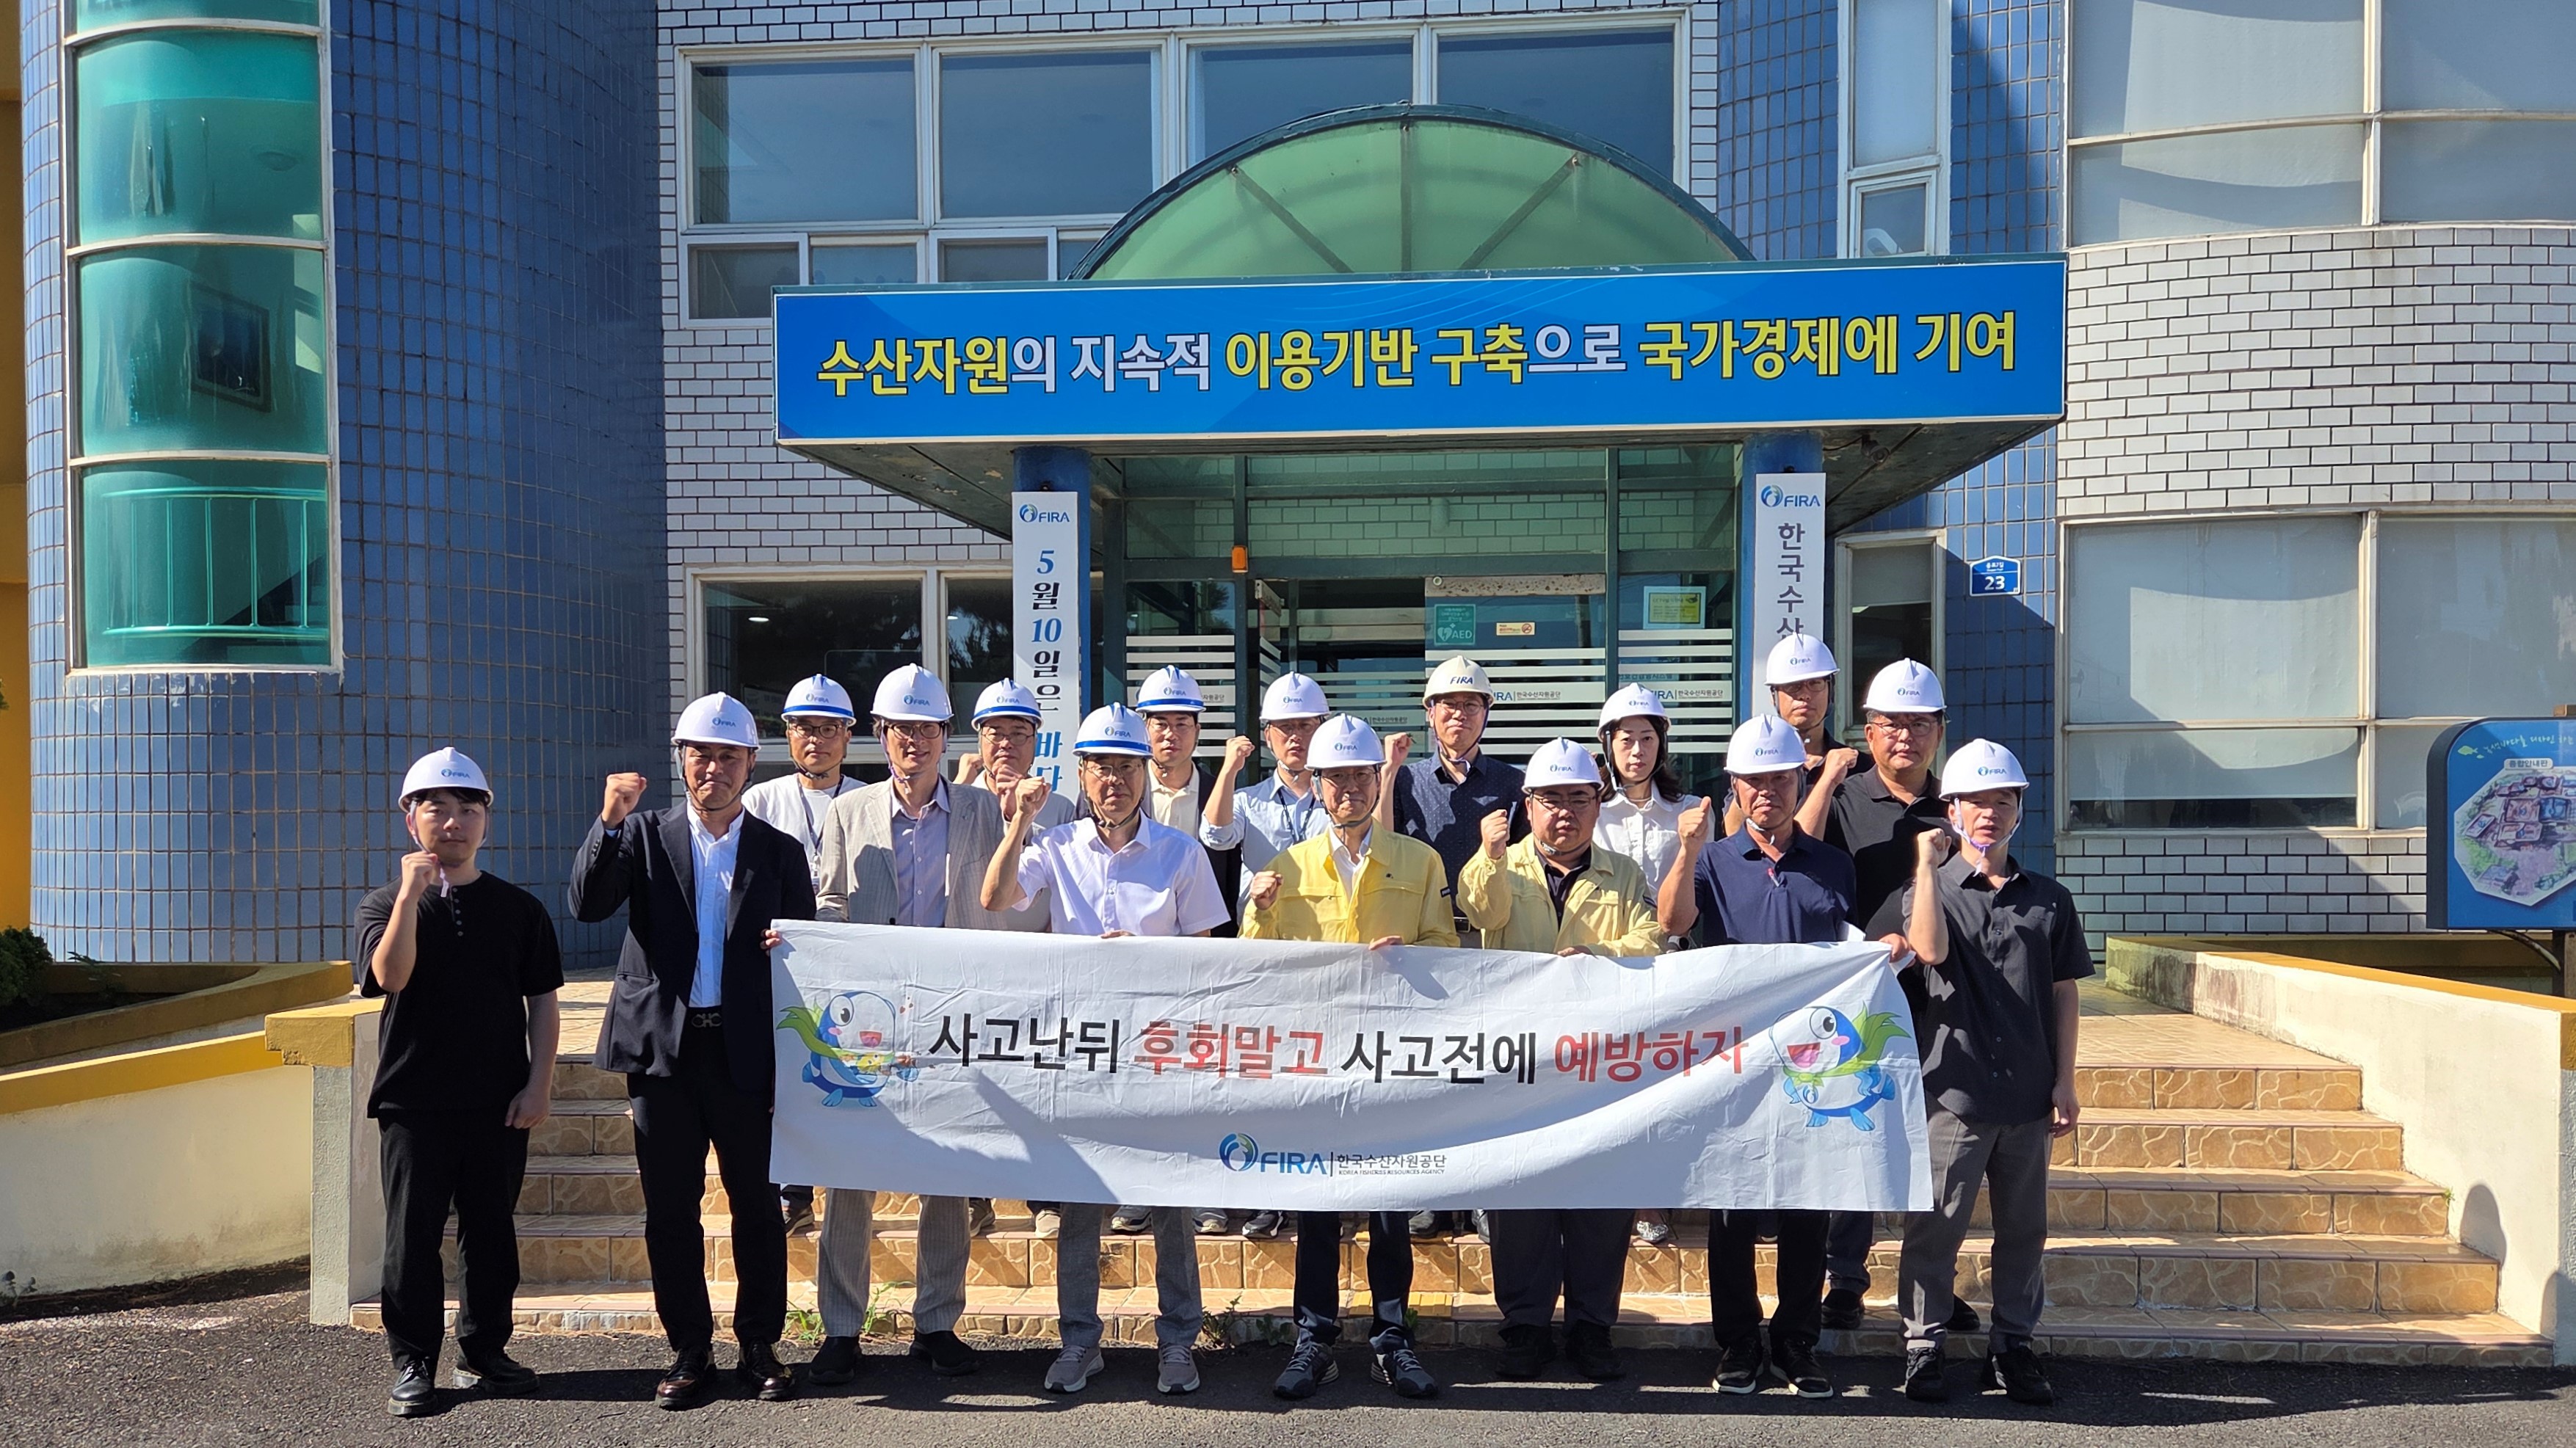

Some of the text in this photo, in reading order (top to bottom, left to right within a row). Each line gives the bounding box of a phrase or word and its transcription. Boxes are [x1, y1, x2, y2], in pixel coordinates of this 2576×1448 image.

[817, 310, 2017, 397] 수산자원의 지속적 이용기반 구축으로 국가경제에 기여
[1784, 495, 1821, 507] FIRA
[1038, 512, 1070, 523] FIRA
[1984, 575, 2005, 590] 23
[1451, 630, 1473, 639] AED
[1450, 676, 1473, 685] FIRA
[1494, 691, 1513, 701] IRA
[1652, 690, 1674, 699] IRA
[928, 1013, 1749, 1085] 사고난뒤 후회말고 사고전에 예방하자
[1260, 1152, 1447, 1175] FIRA 한국수산자원공단
